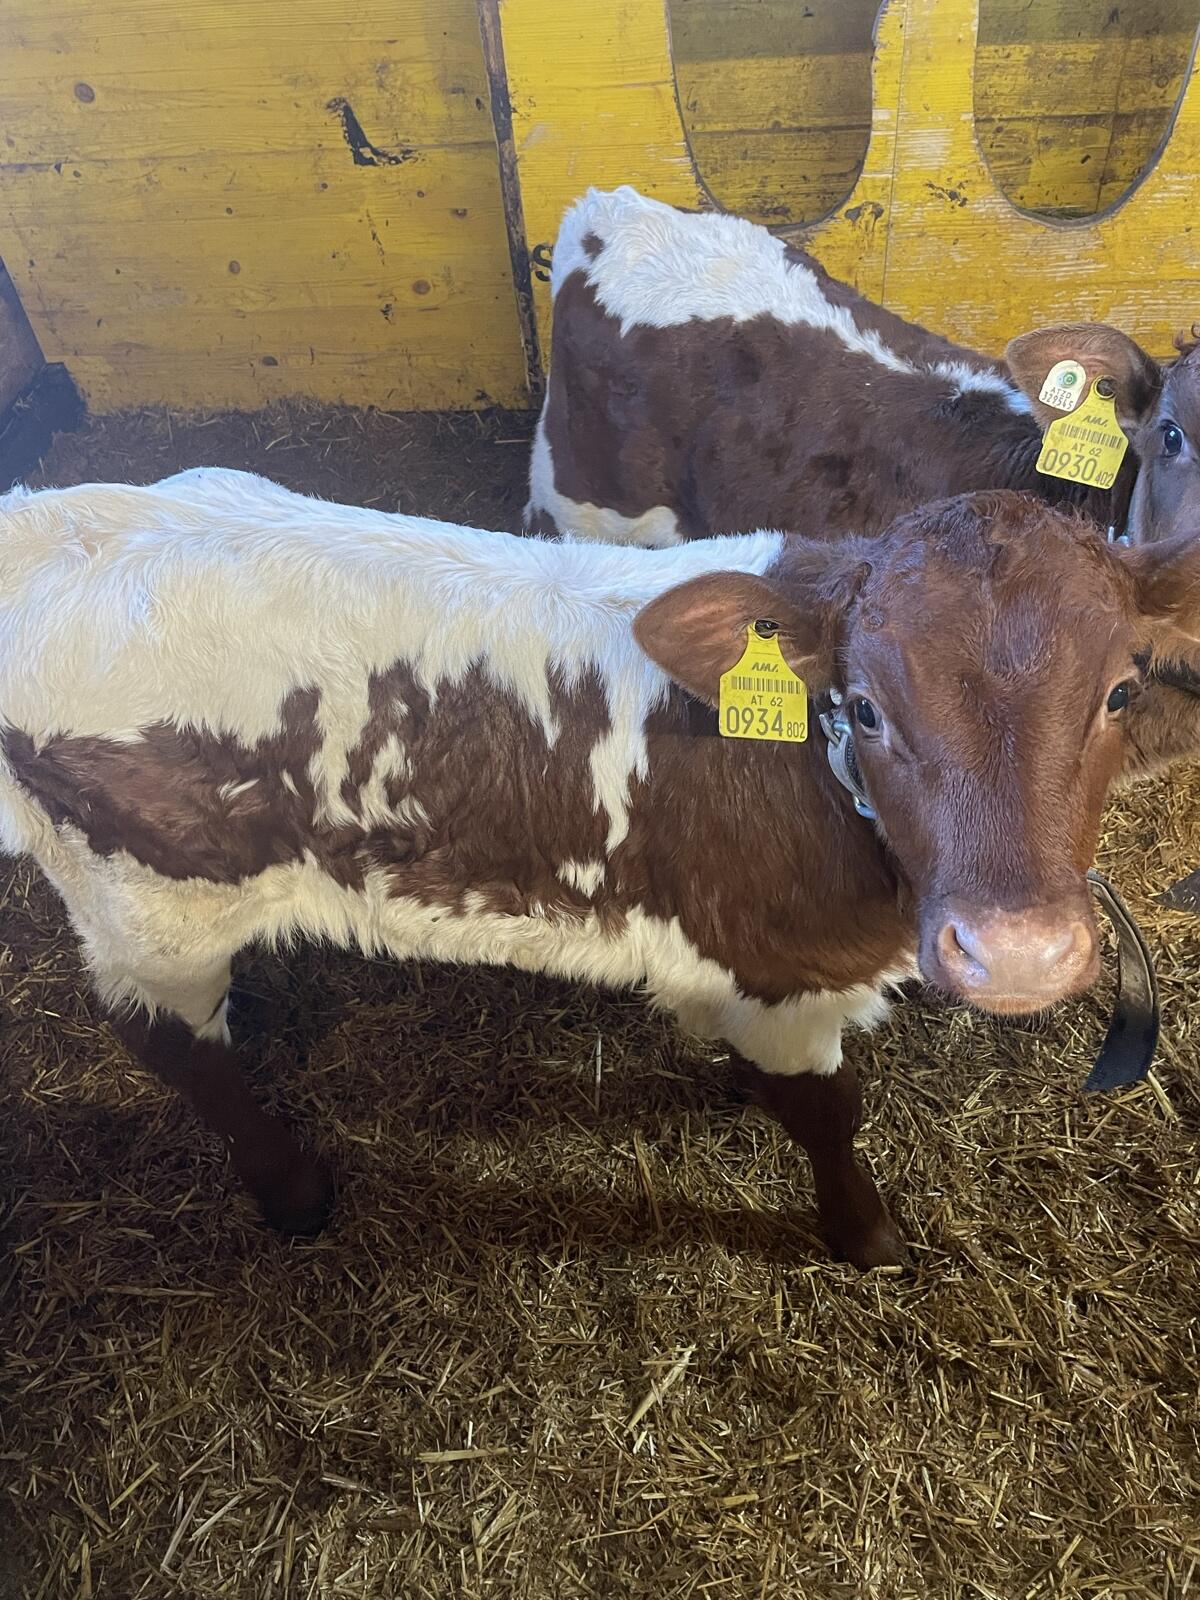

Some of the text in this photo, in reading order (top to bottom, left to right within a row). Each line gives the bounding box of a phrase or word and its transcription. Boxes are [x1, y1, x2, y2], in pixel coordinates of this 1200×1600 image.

[1071, 443, 1102, 458] AT 62
[1042, 448, 1114, 487] 0930 402
[751, 695, 783, 707] AT 62
[726, 705, 805, 739] 0934 802
